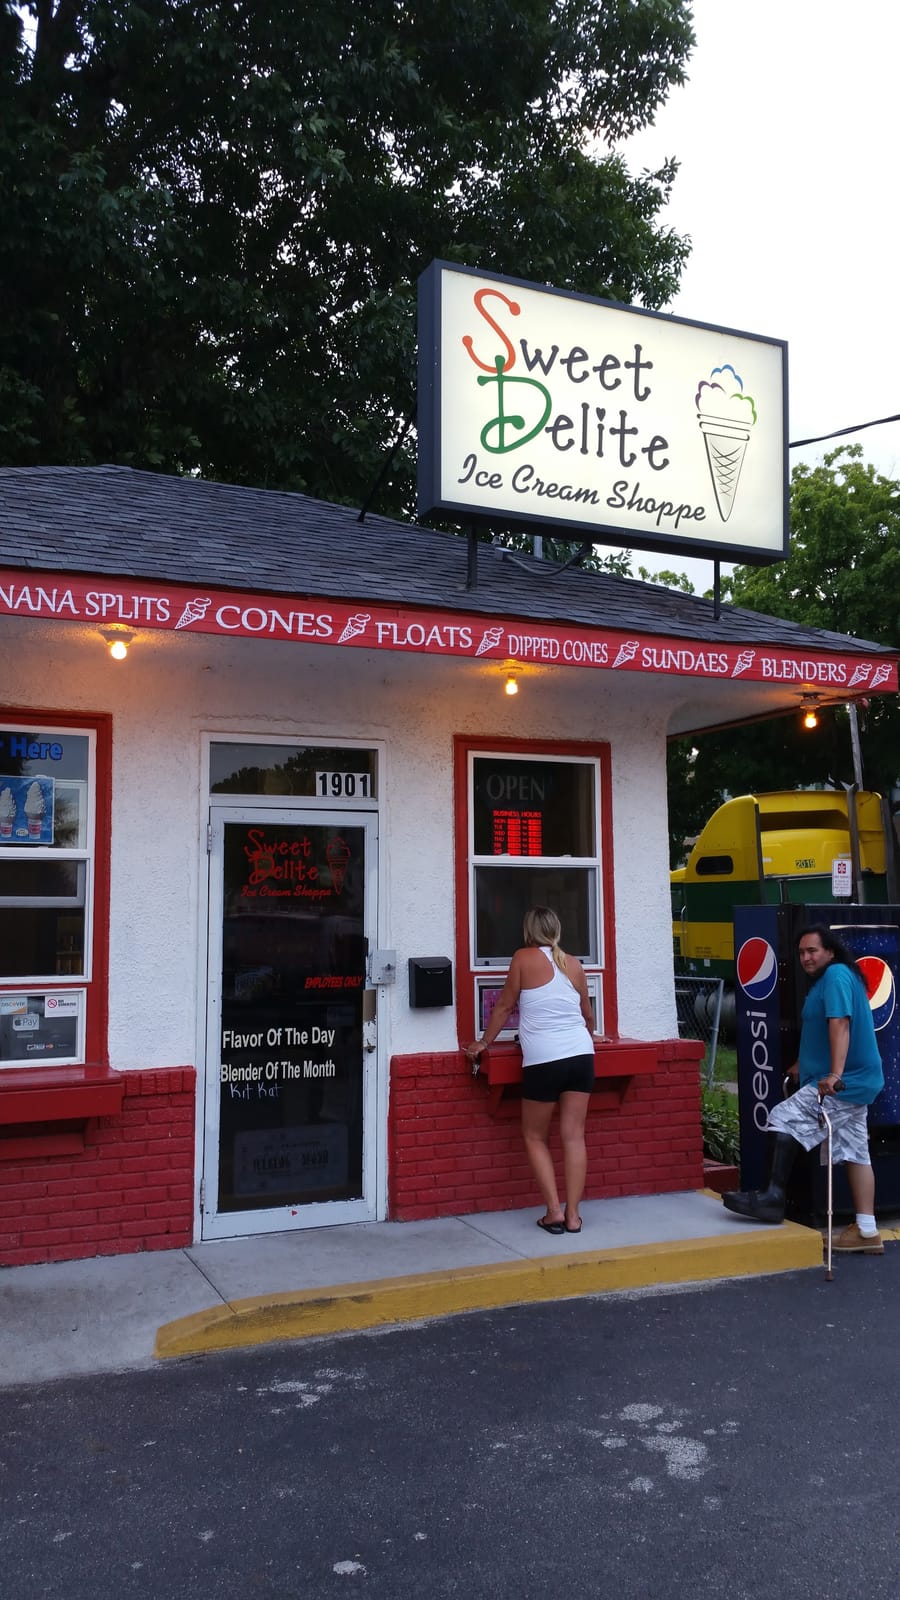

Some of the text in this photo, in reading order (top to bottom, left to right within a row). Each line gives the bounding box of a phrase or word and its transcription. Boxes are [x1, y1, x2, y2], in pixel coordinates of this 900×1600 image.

[462, 288, 653, 402] Sweet
[477, 355, 669, 471] Delite
[458, 454, 707, 529] Ice Cream Shoppe
[85, 591, 170, 622] SPLITS
[215, 605, 333, 638] CONES
[375, 621, 473, 648] FLOATS
[507, 634, 560, 659] DIPPED
[562, 639, 609, 664] CONES
[641, 647, 729, 673] SUNDAES
[760, 657, 847, 682] BLENDERS
[10, 735, 63, 760] Here
[319, 772, 369, 797] 1901
[486, 774, 545, 801] OPEN
[243, 829, 311, 859] Sweet
[248, 850, 320, 885] Delite
[240, 884, 332, 901] Ice Cream Shoppe
[304, 975, 363, 989] EMPLOYEES ONLY
[222, 1026, 336, 1049] Flavor Of The Day
[221, 1059, 336, 1082] Blender Of The Month
[746, 1010, 774, 1133] pepsi
[230, 1081, 283, 1100] Kit Kat
